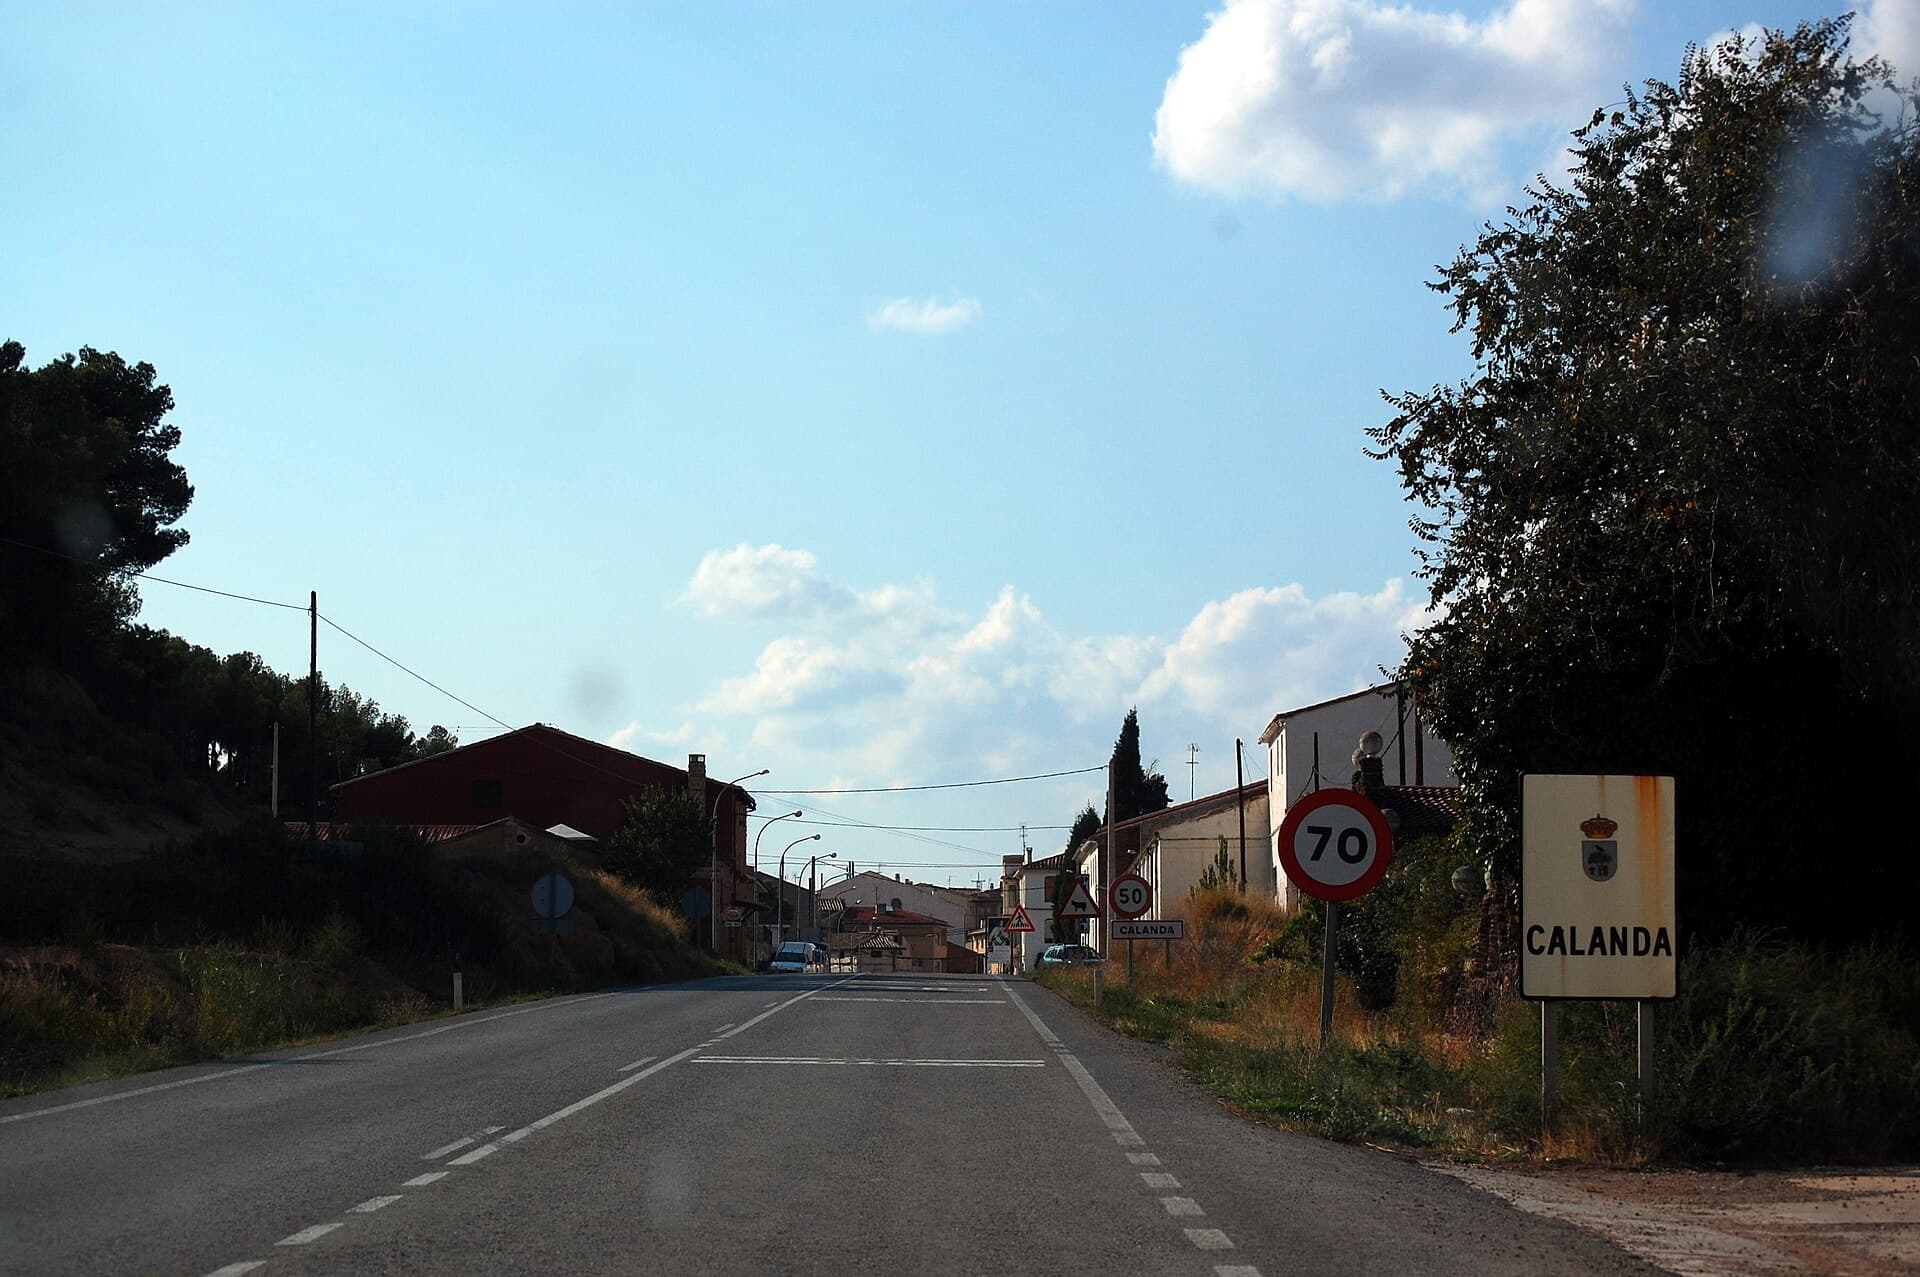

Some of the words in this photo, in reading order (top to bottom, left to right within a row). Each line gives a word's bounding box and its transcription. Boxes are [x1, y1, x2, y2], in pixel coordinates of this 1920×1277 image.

[1307, 826, 1368, 864] 70
[1119, 888, 1142, 904] 50
[1120, 925, 1175, 935] CALANDA
[1527, 925, 1672, 956] CALANDA
